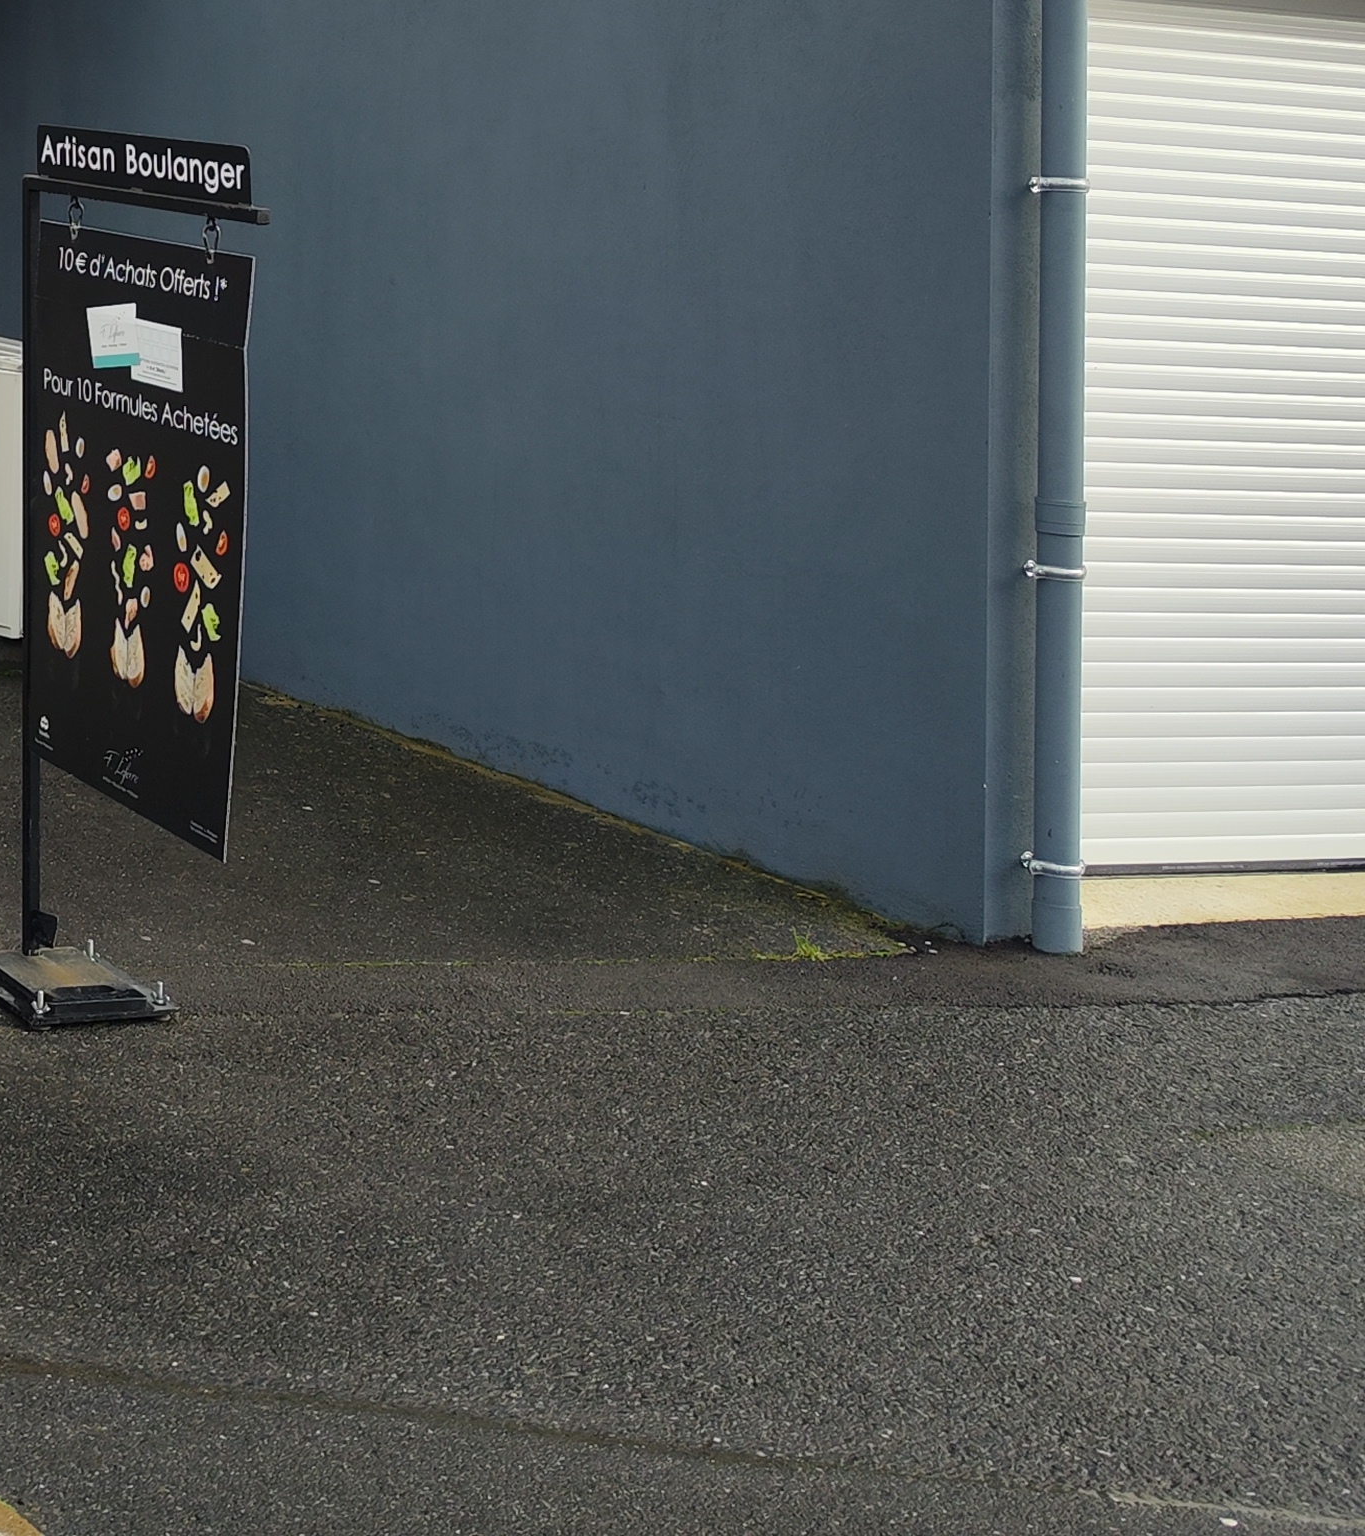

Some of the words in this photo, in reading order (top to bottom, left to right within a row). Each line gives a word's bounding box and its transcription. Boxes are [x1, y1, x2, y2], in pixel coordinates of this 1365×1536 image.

[41, 135, 116, 173] Artisan
[126, 144, 246, 194] Boulanger
[59, 247, 88, 274] 10€
[90, 253, 158, 289] d'Achats
[160, 267, 212, 300] Offerts
[44, 367, 74, 397] Pour
[77, 377, 93, 402] 10
[95, 382, 158, 423] Formules
[161, 402, 239, 445] Achetées
